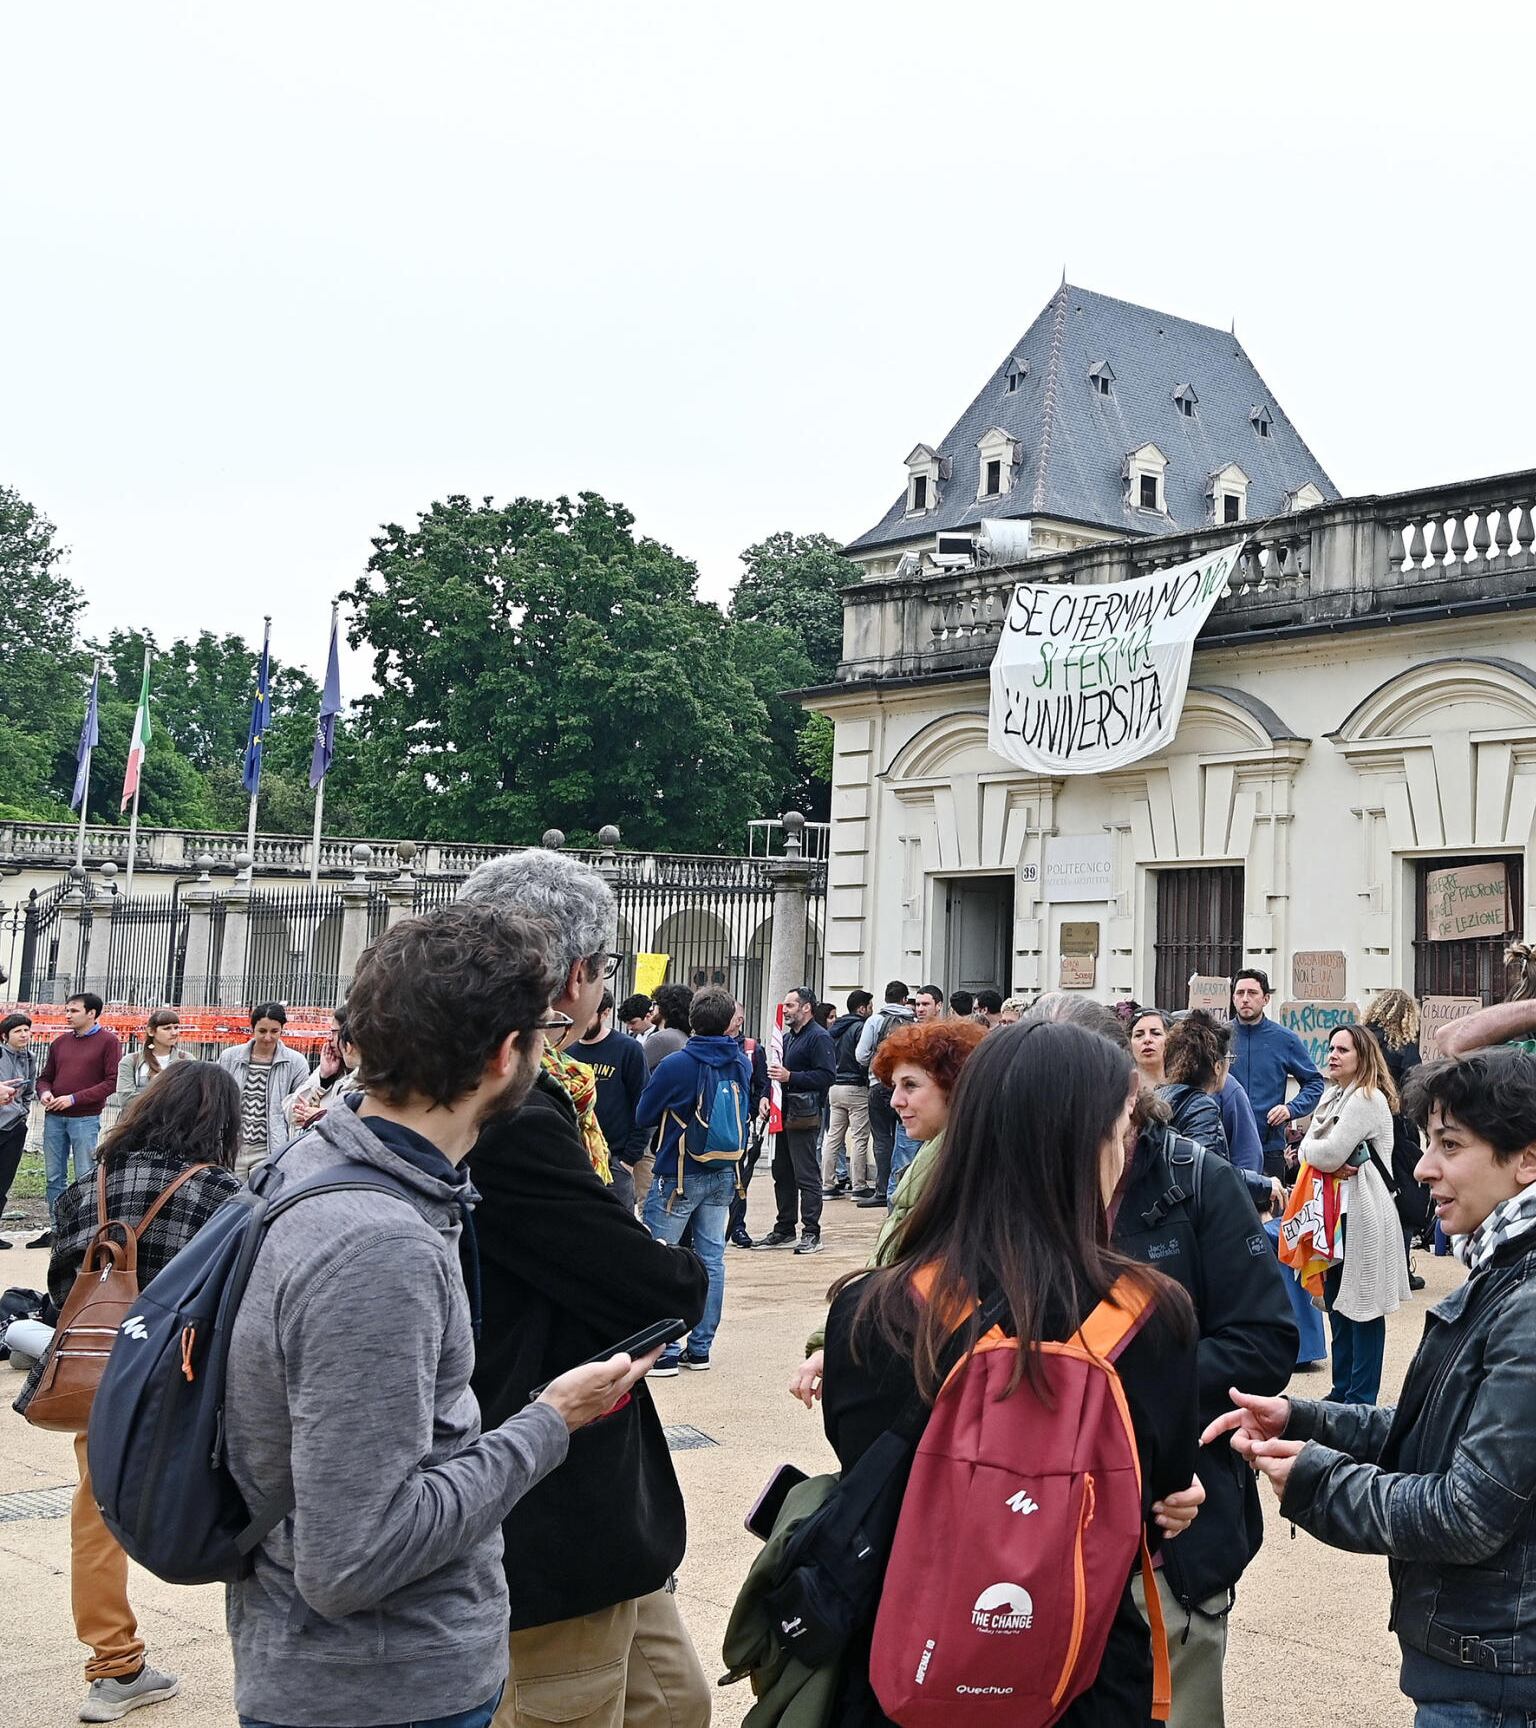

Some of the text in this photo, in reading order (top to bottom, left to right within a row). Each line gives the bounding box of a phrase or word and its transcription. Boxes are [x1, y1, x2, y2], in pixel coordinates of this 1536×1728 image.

[1009, 586, 1049, 636] SE
[1050, 594, 1076, 637] CI
[1072, 570, 1201, 642] FERMIAMO
[1033, 624, 1153, 692] SI FERMA
[1023, 865, 1036, 879] 39
[1047, 861, 1111, 875] POLITECNICO
[1458, 880, 1505, 902] PADRONE
[1148, 1248, 1180, 1259] Wolfskin
[1149, 1244, 1165, 1252] Jack
[971, 1610, 1034, 1629] THE CHANGE
[956, 1685, 1014, 1695] Quechua
